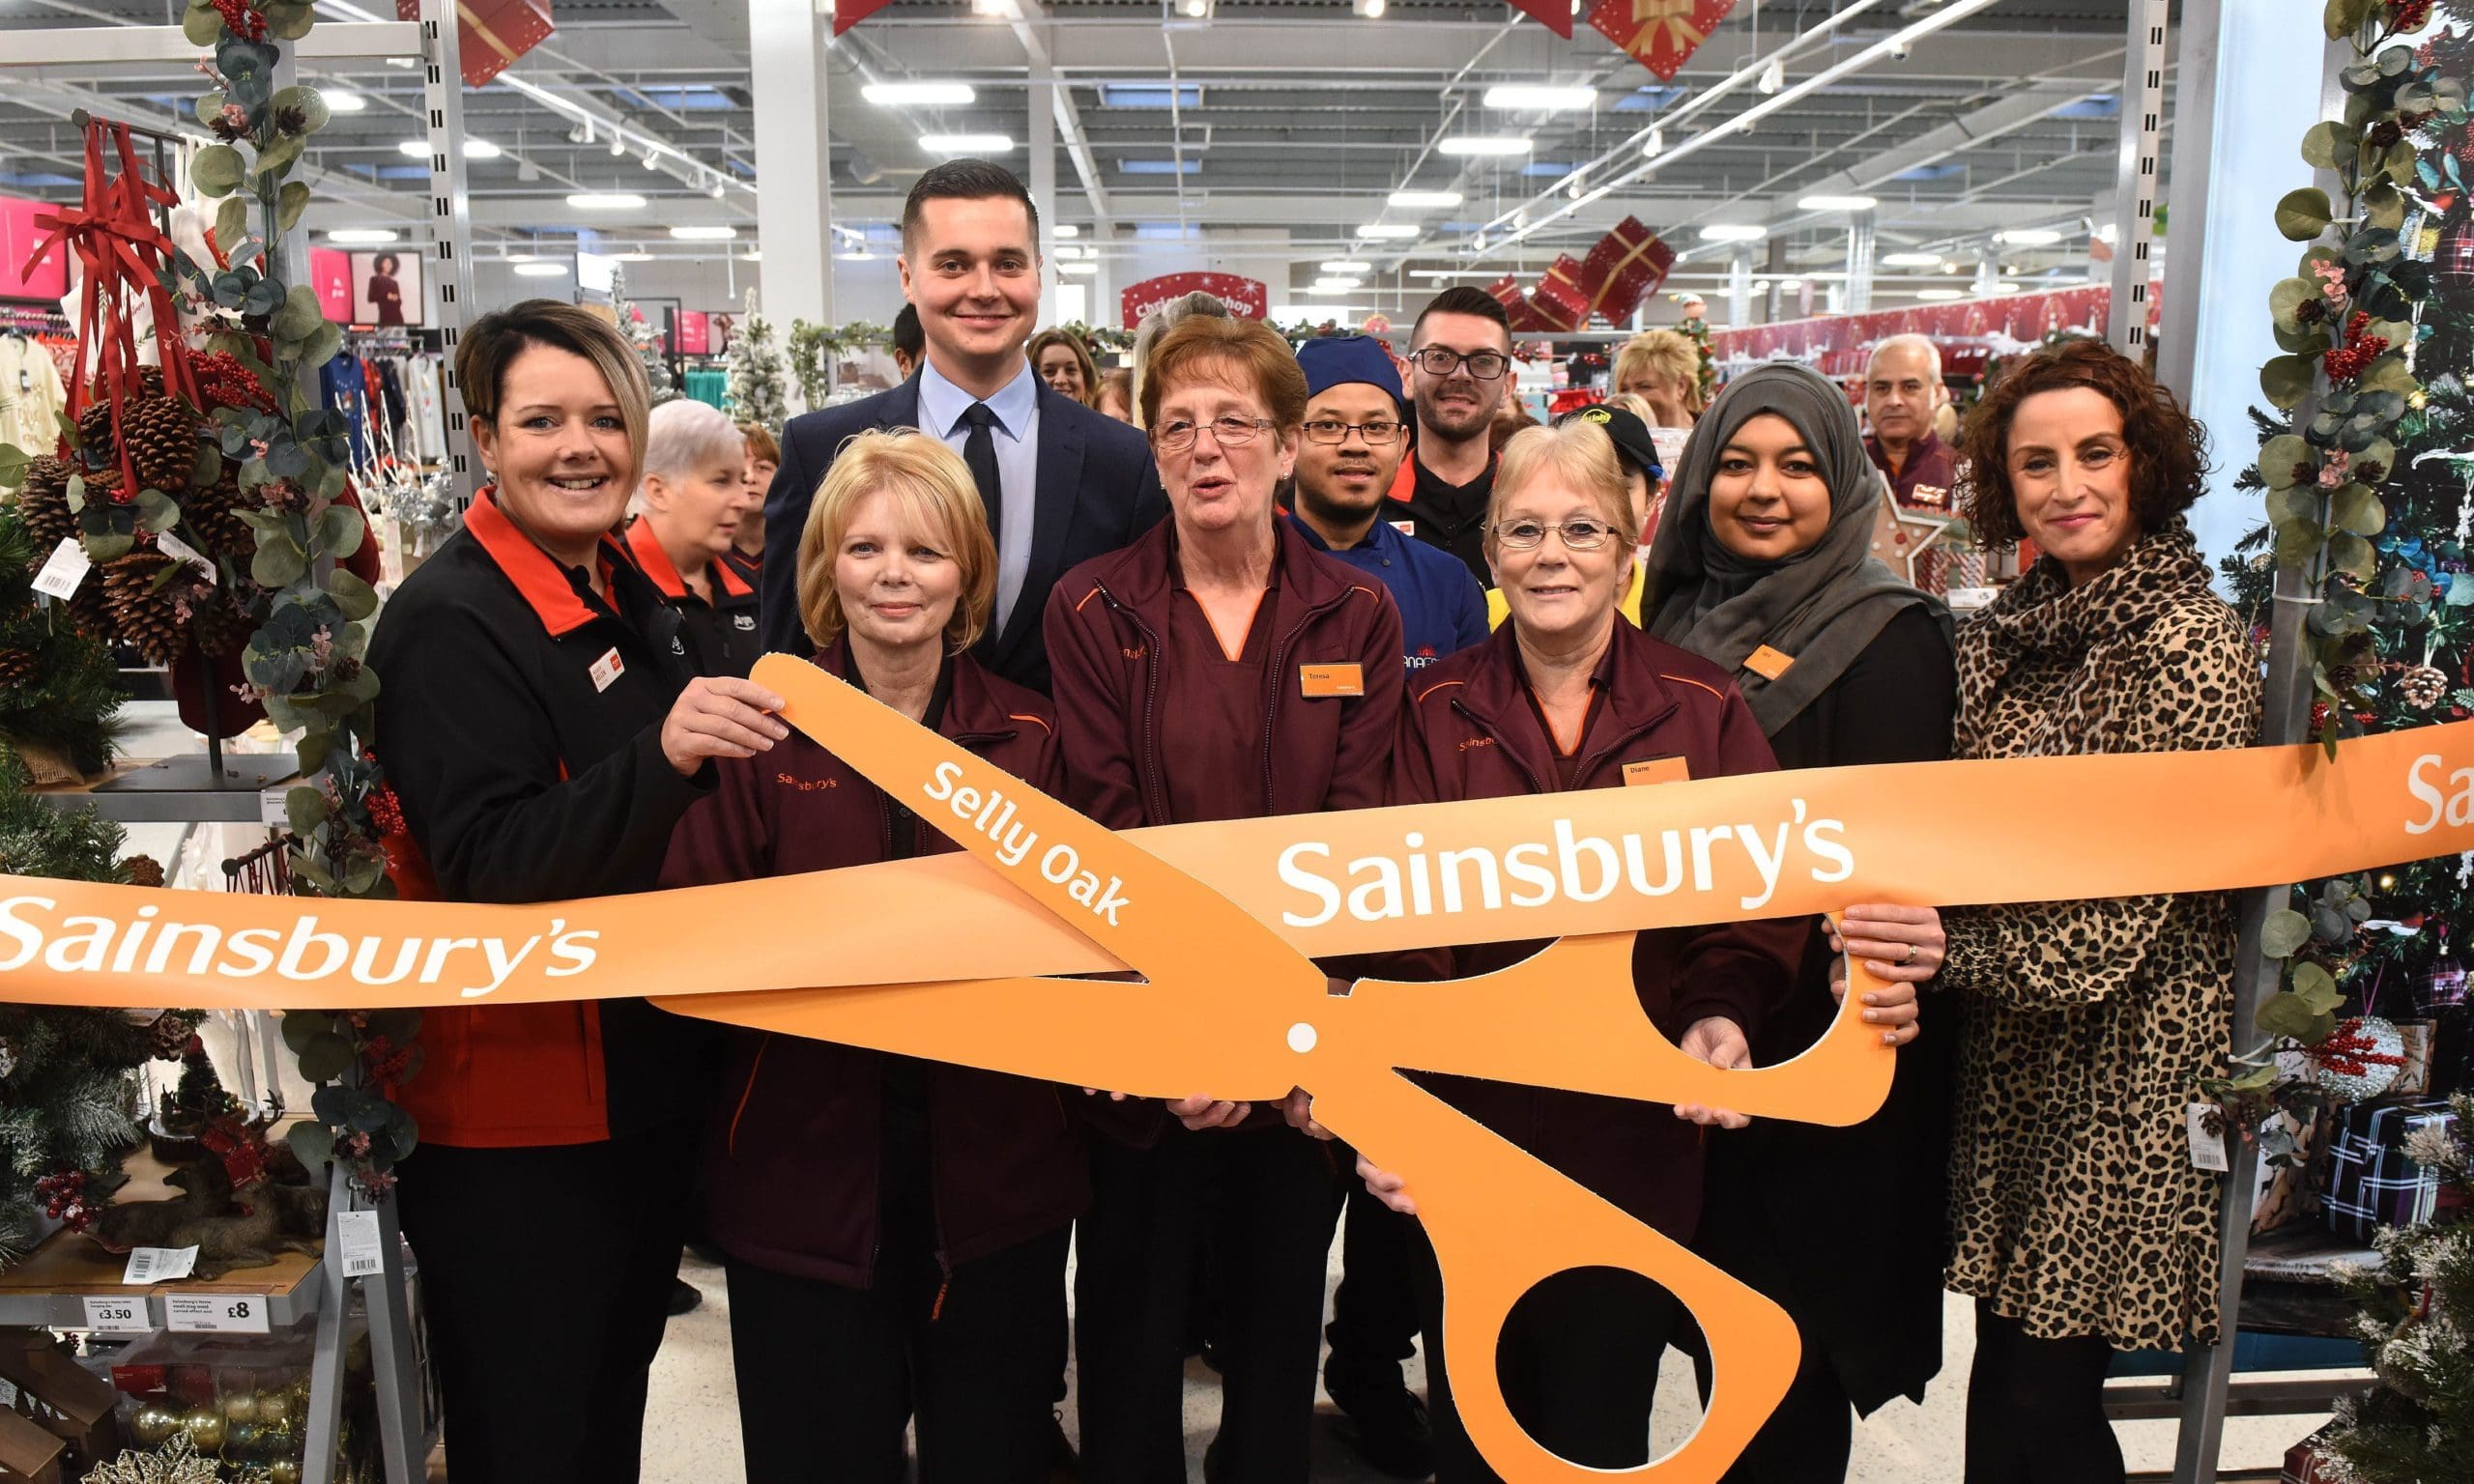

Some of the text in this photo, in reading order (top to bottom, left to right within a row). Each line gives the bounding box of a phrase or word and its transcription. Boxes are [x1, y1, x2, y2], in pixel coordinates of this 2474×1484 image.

[923, 761, 1130, 927] Selly Oak
[1276, 799, 1856, 928] Sainsbury's
[0, 895, 601, 998] Sainsbury's
[99, 1309, 132, 1320] £3.50
[227, 1301, 250, 1319] £8
